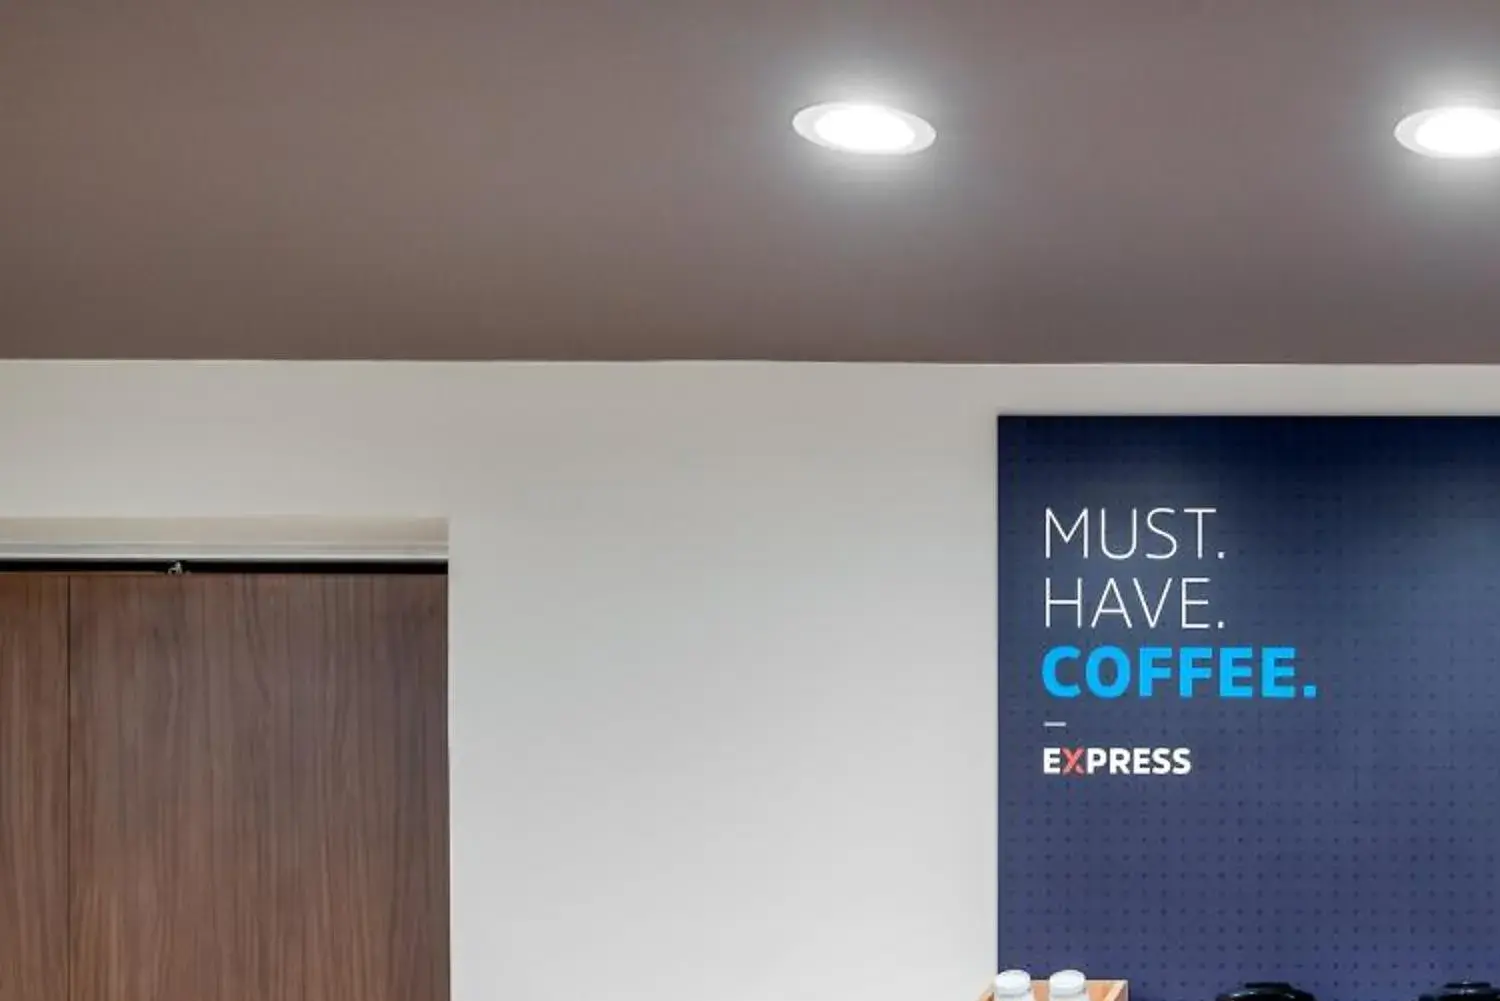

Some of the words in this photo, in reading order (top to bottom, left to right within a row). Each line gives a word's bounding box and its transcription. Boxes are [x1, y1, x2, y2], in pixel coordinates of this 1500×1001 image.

[1045, 507, 1225, 559] MUST.
[1045, 577, 1225, 629] HAVE.
[1041, 645, 1317, 698] COFFEE.
[1043, 747, 1192, 775] EXPRESS
